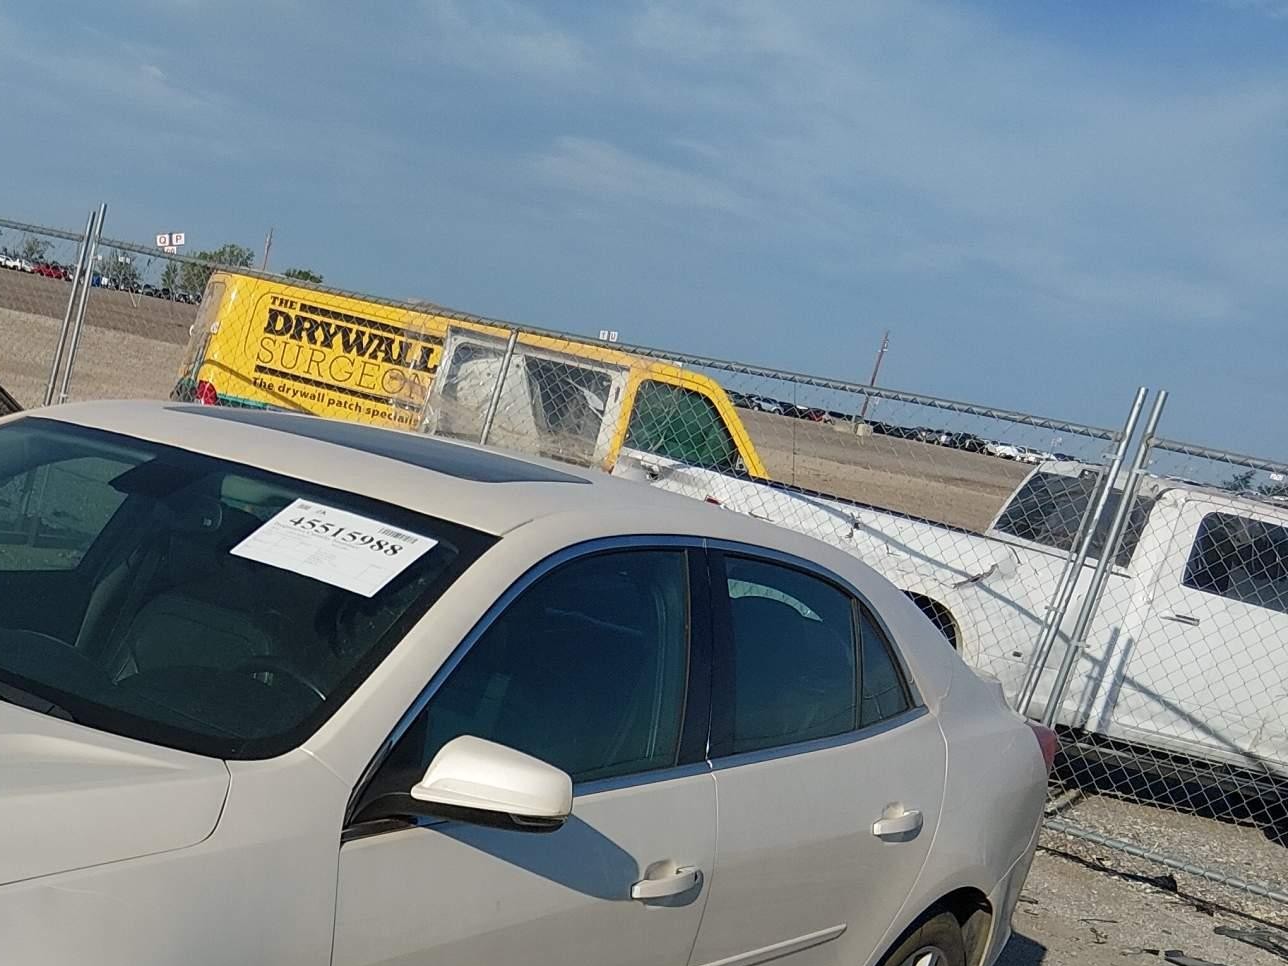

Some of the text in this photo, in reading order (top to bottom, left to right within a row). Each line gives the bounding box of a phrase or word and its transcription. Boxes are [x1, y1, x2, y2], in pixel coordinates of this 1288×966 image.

[270, 295, 298, 311] THE
[263, 307, 439, 374] DRYWALL
[255, 335, 433, 401] SURGEON
[251, 376, 275, 392] The
[277, 382, 325, 404] drywall
[327, 396, 363, 413] patch
[289, 516, 404, 557] 45515988
